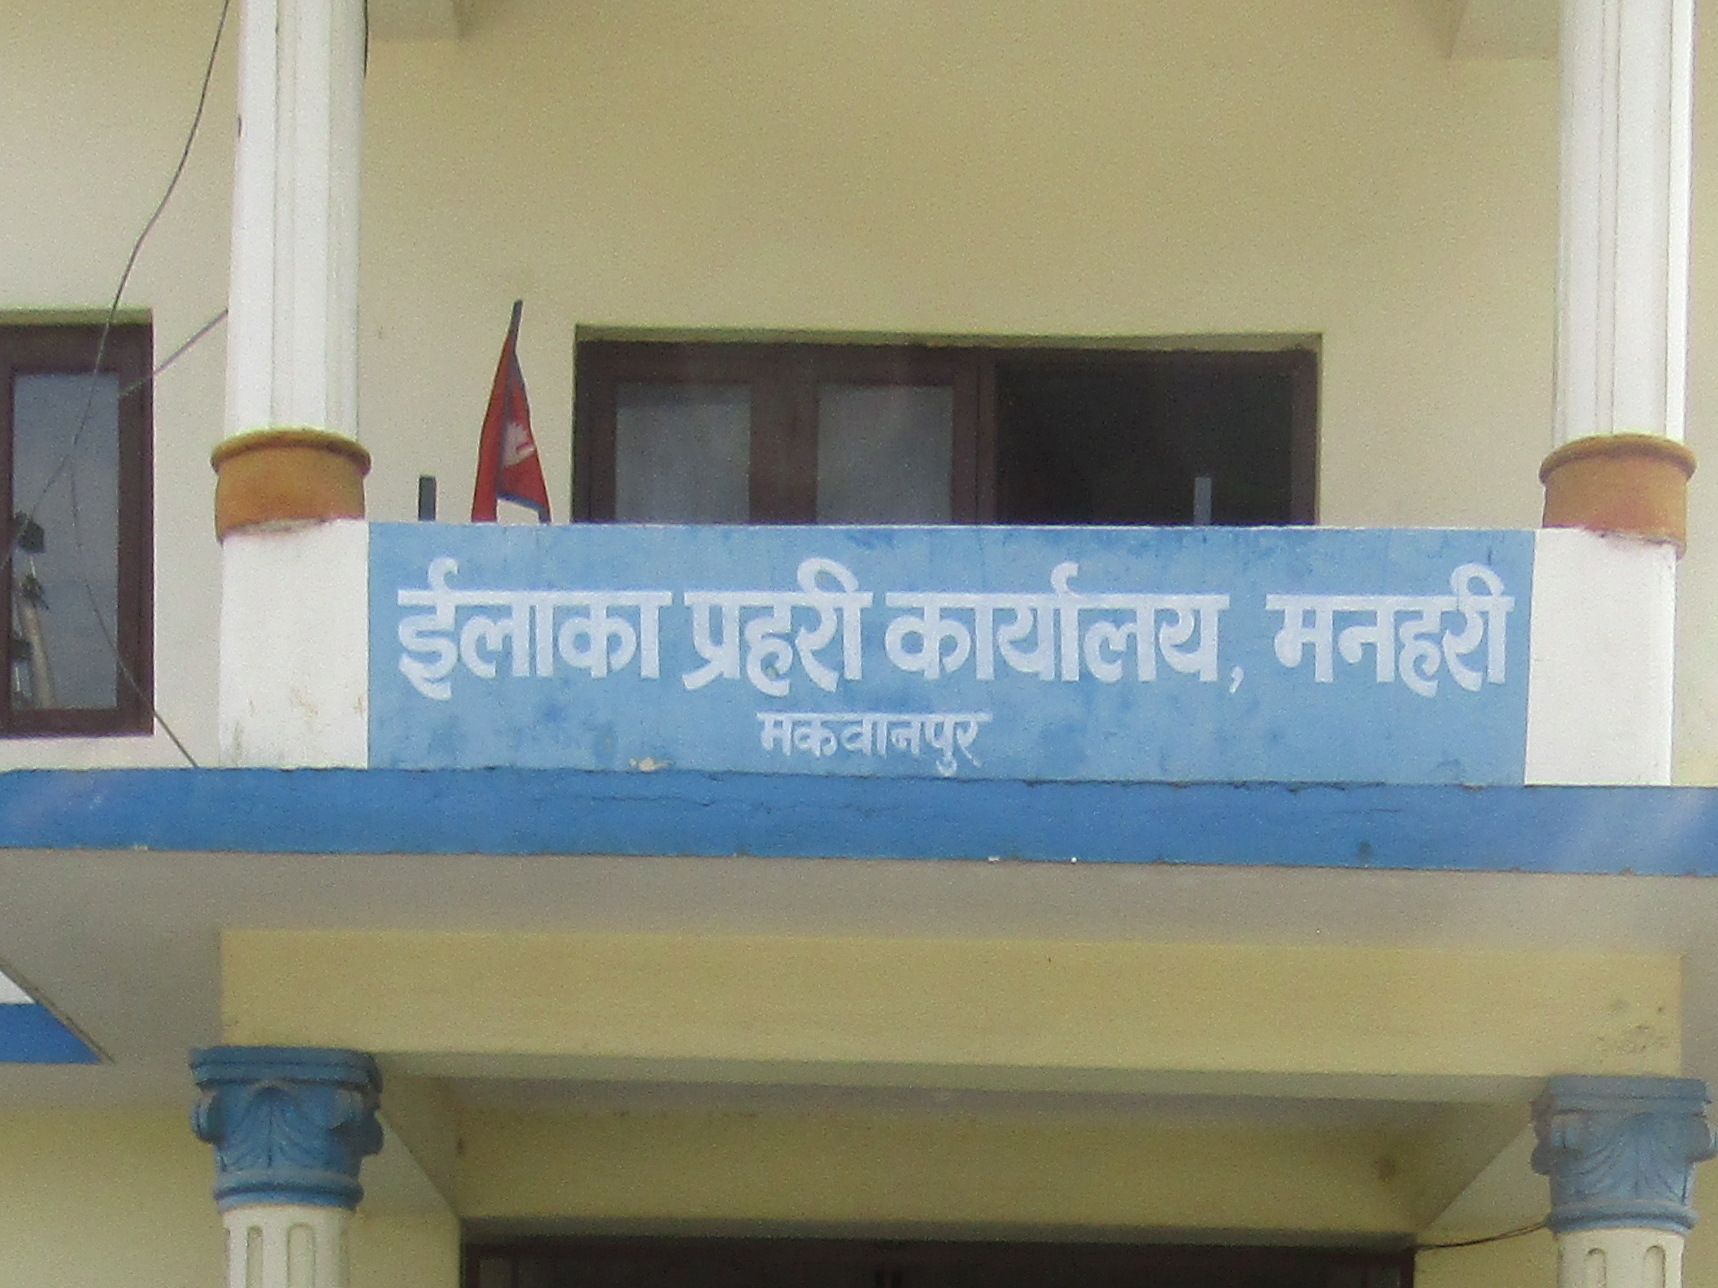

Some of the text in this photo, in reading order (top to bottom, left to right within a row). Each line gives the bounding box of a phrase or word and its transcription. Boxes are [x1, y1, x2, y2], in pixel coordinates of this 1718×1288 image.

[397, 556, 1515, 700] ईलाका प्रहरी कार्यालय, मनहरी
[756, 712, 994, 777] मकवानपुर
